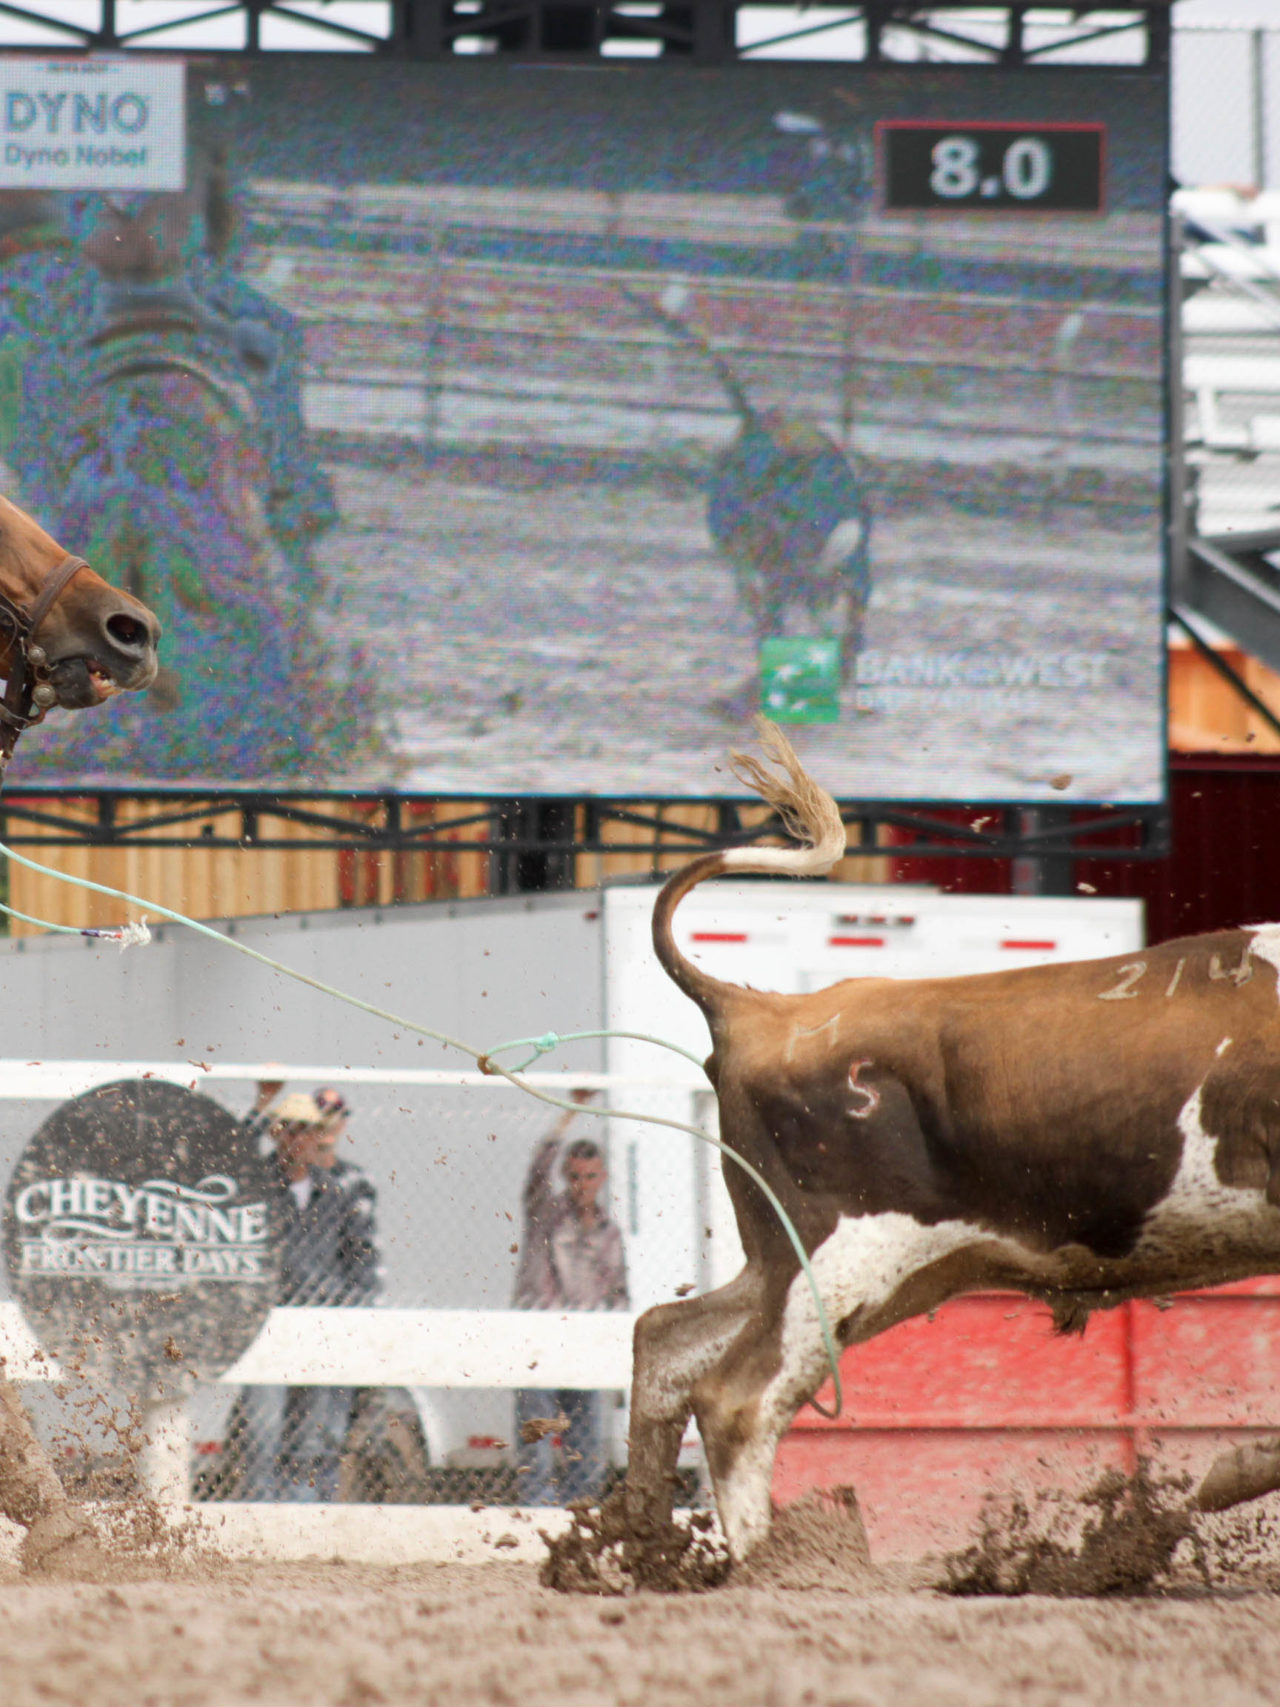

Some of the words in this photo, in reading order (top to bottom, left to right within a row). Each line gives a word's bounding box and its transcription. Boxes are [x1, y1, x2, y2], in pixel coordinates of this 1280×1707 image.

[5, 91, 149, 134] DYNO
[5, 142, 70, 170] Dyno
[76, 144, 146, 168] Nobel
[929, 136, 1052, 199] 8.0
[15, 1176, 269, 1244] CHEYENNE
[23, 1245, 176, 1272] FRONTIER
[182, 1249, 262, 1274] DAYS
